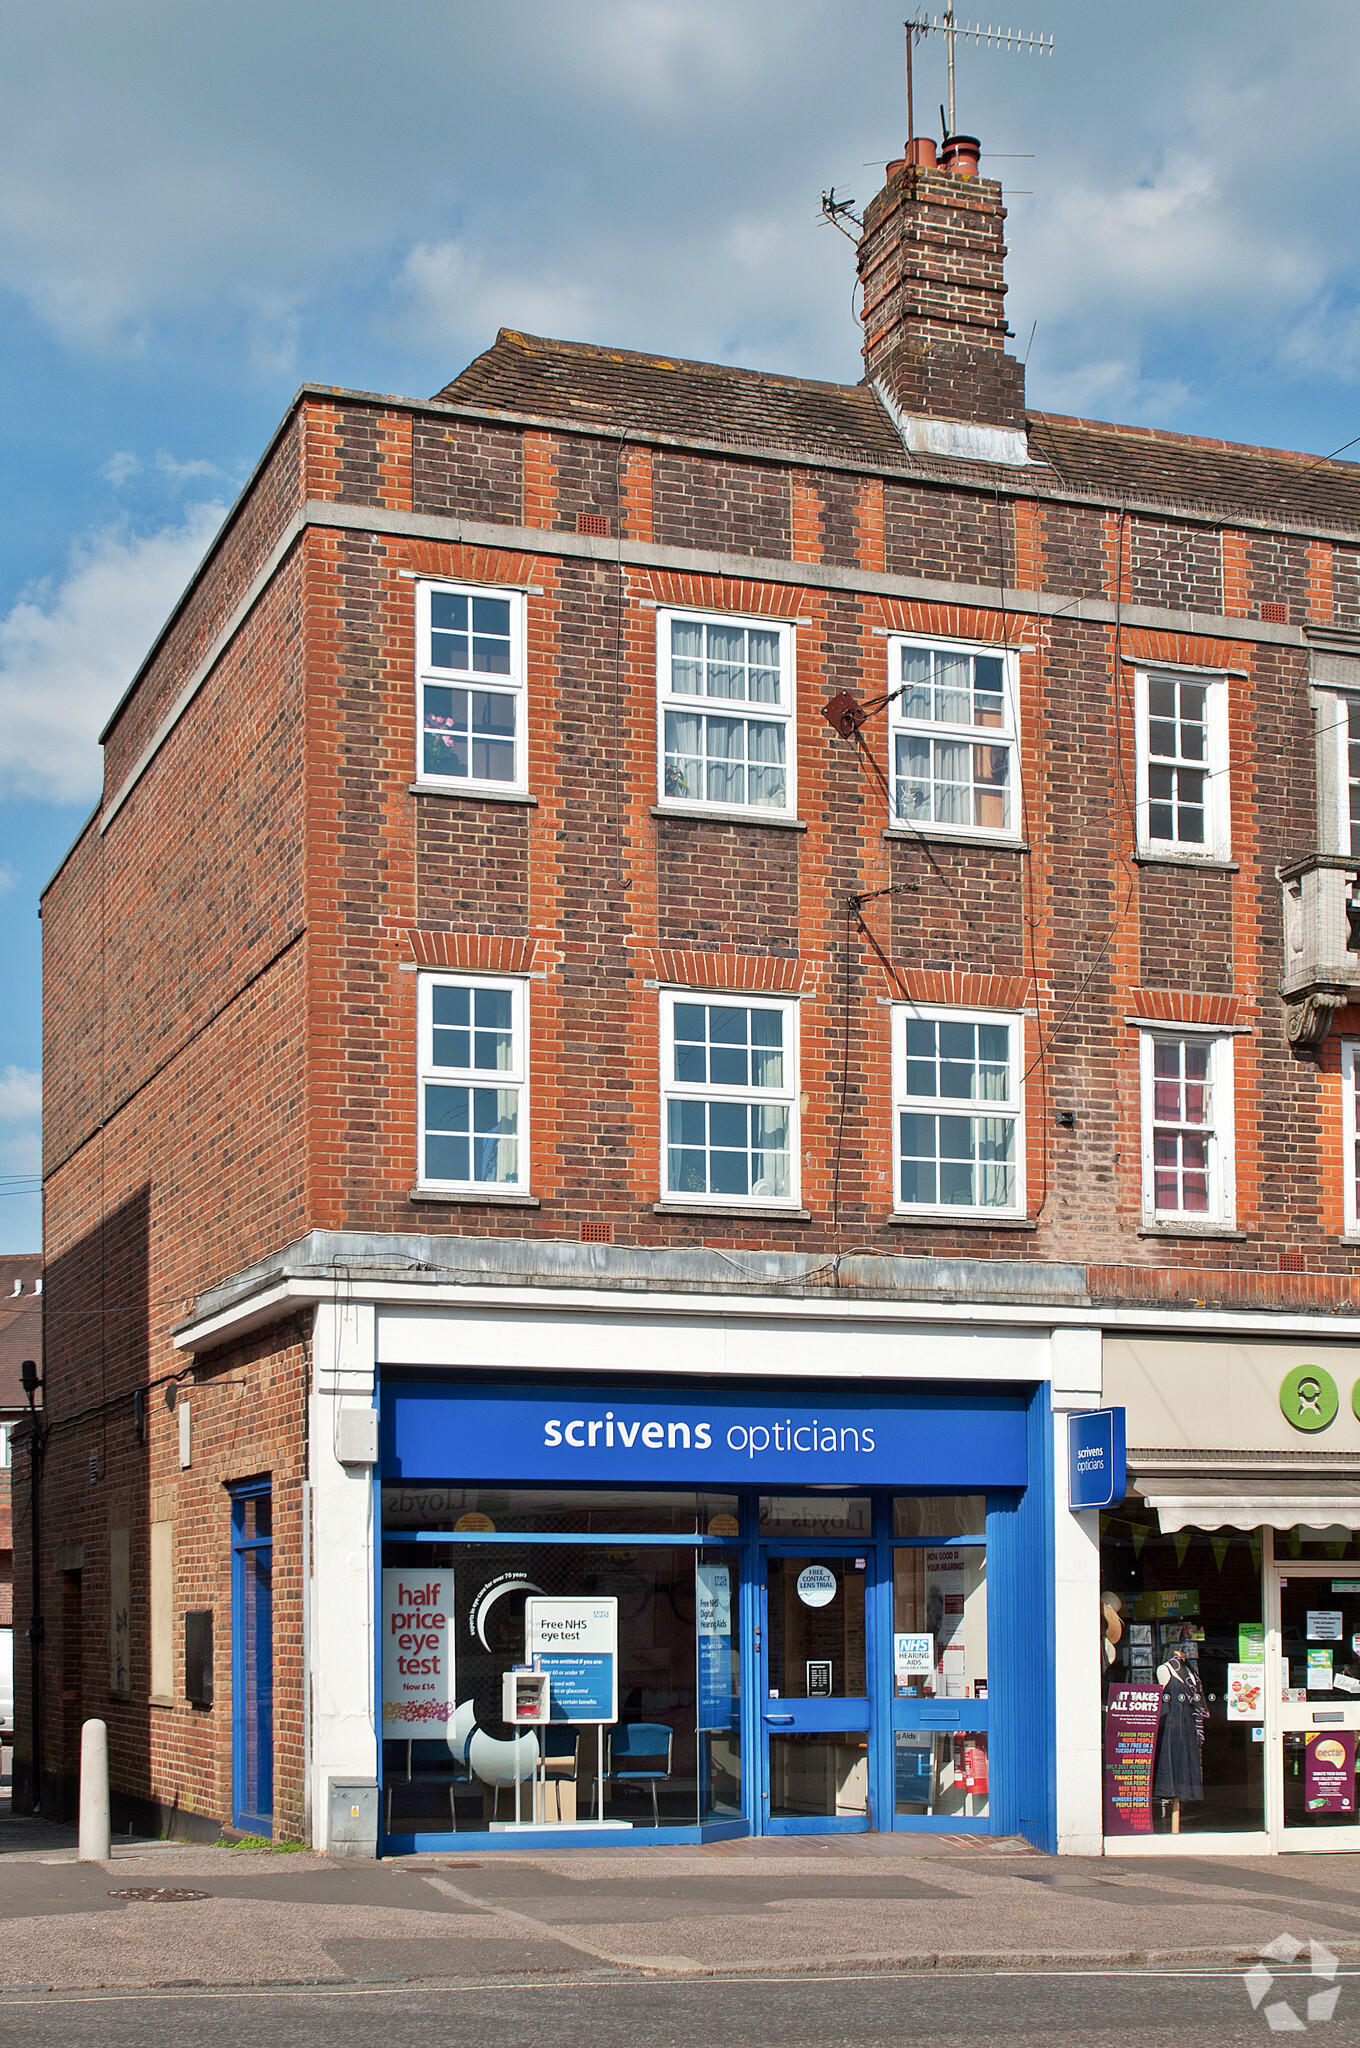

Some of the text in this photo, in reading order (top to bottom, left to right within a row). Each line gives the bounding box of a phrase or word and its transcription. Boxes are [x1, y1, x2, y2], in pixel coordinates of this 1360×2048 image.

[544, 1412, 875, 1459] scrivens opticians
[1078, 1446, 1103, 1459] scrivens
[1077, 1459, 1104, 1474] opticians
[954, 1551, 959, 1559] IS
[927, 1563, 940, 1572] YOUR
[715, 1576, 726, 1586] NHS
[398, 1583, 441, 1605] half
[700, 1599, 719, 1607] Free NHS
[391, 1607, 446, 1634] price
[701, 1610, 714, 1620] Digital
[541, 1620, 587, 1629] Free NHS
[541, 1632, 580, 1642] eye test
[398, 1633, 440, 1656] eye
[899, 1639, 929, 1652] NHS
[397, 1655, 441, 1675] test
[1119, 1691, 1160, 1701] IT TAKES
[1110, 1701, 1158, 1712] ALL SORTS
